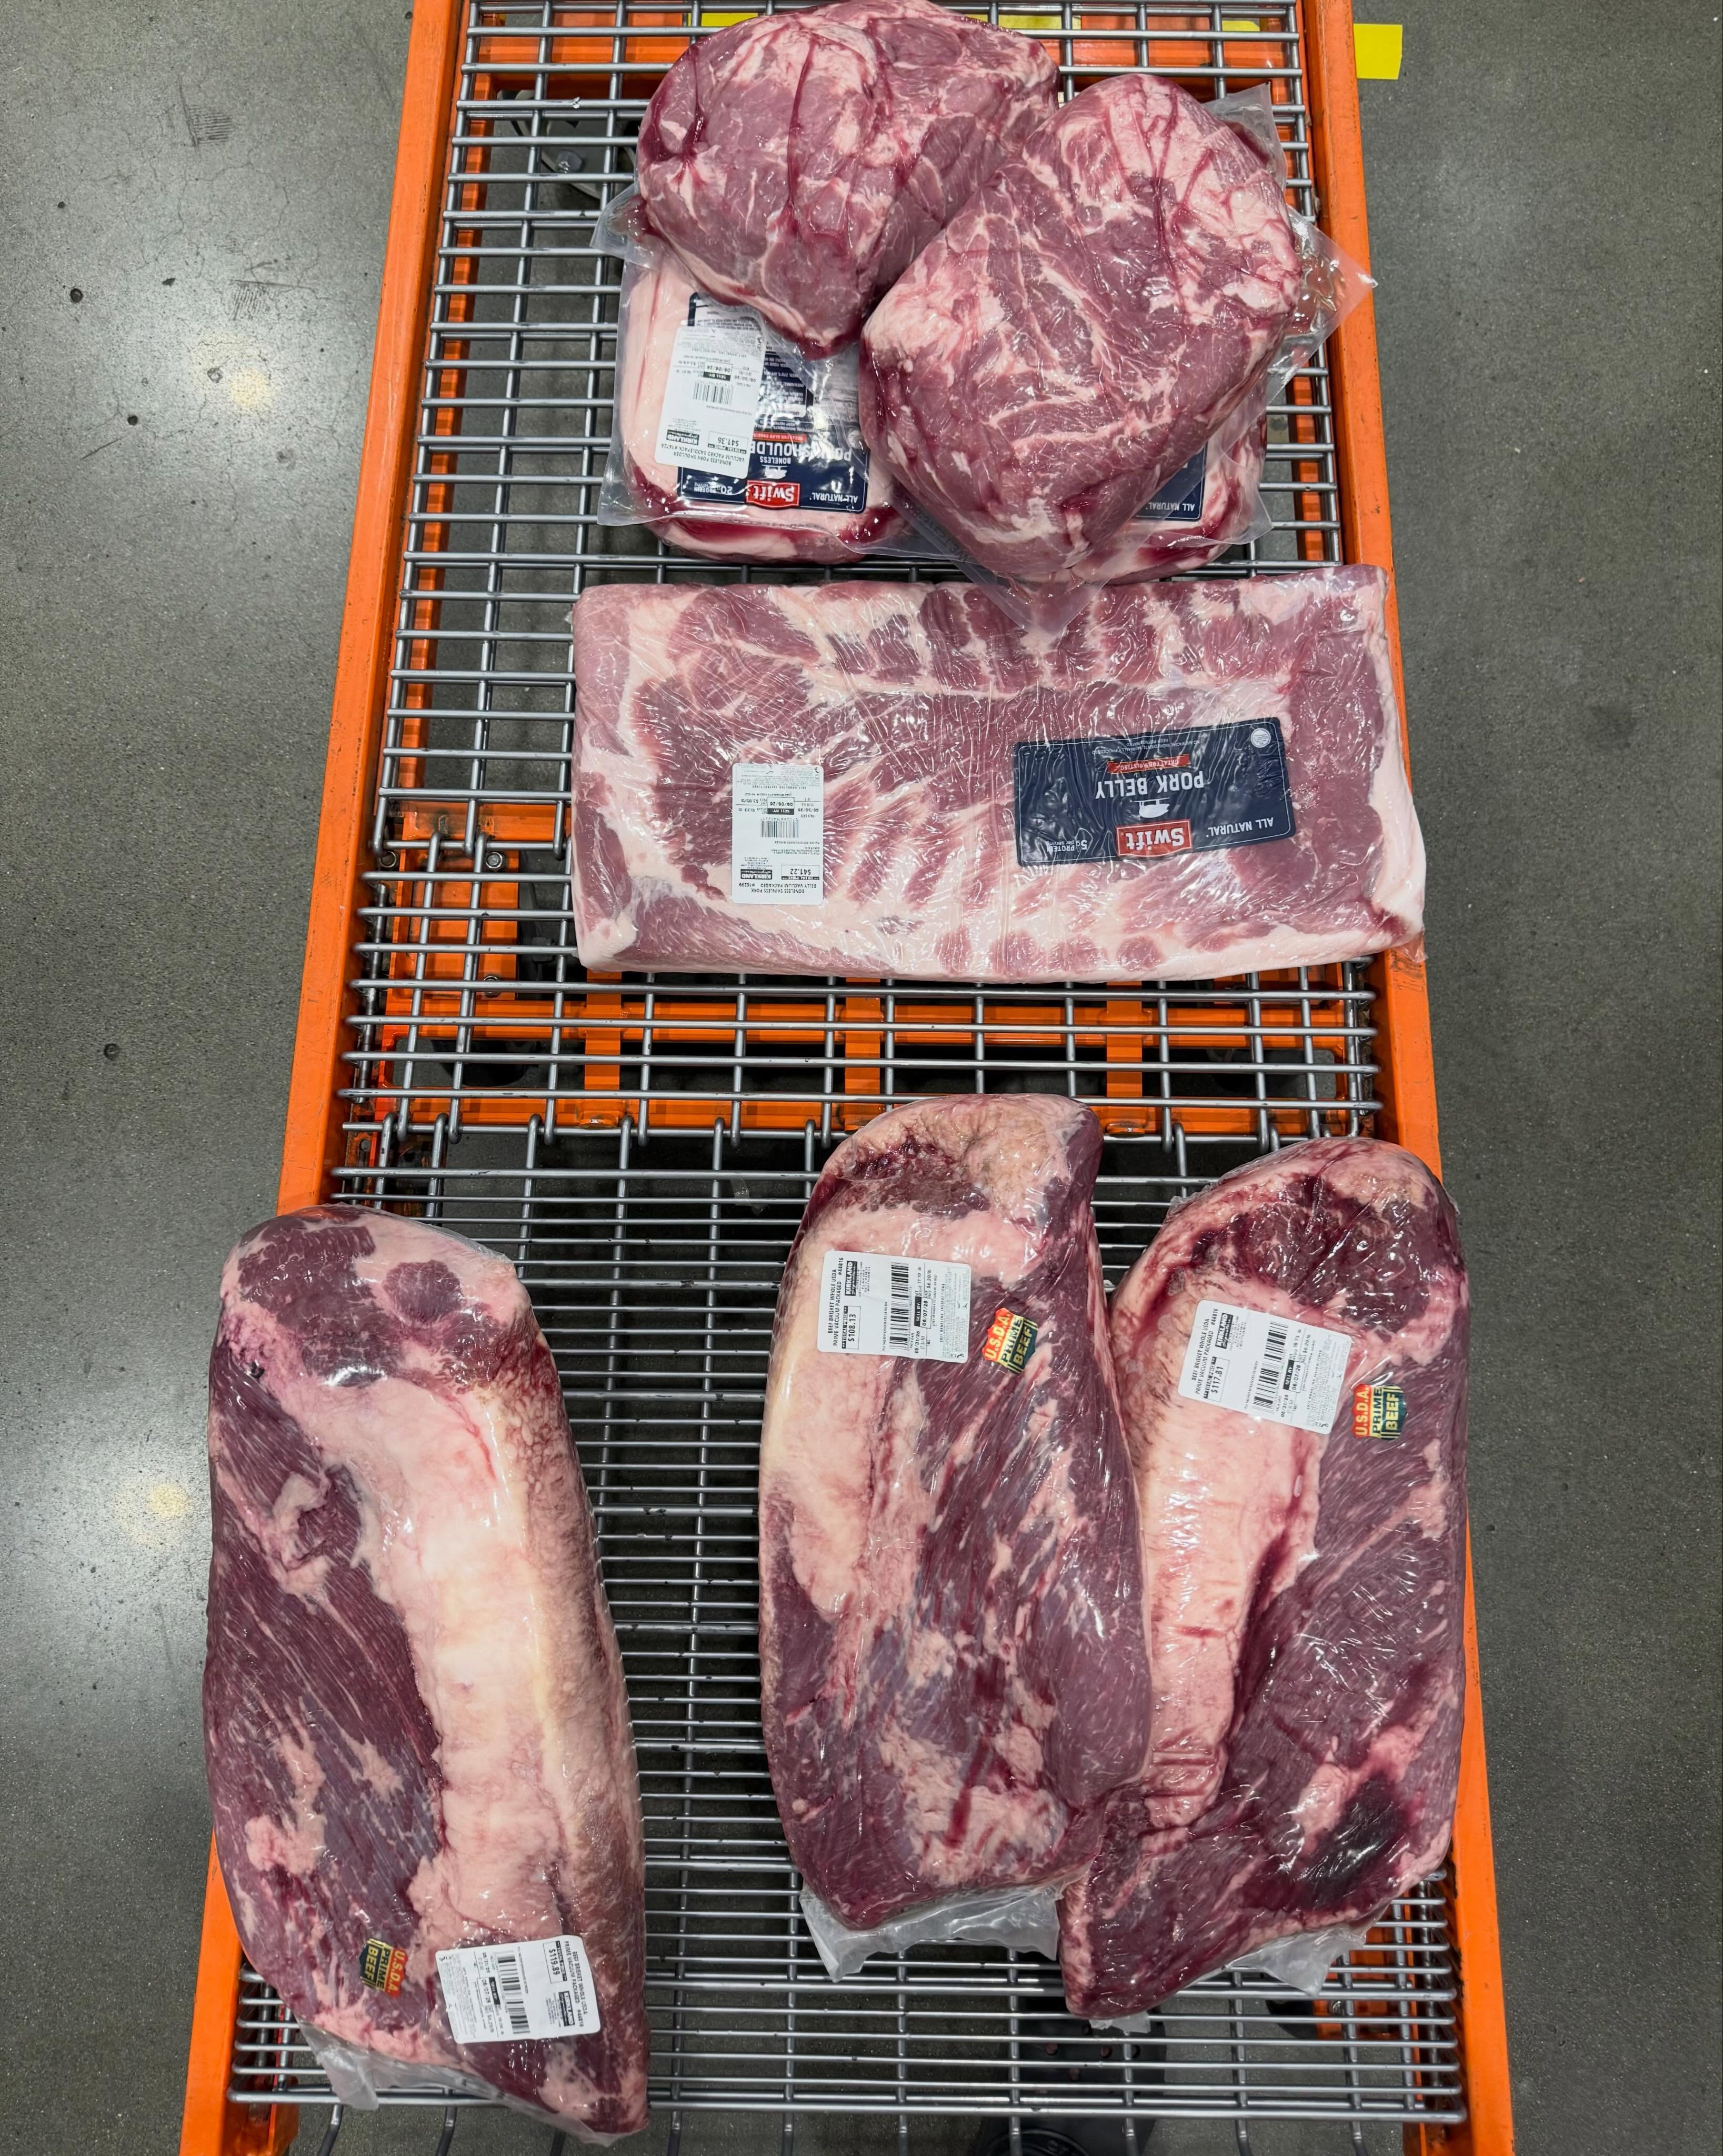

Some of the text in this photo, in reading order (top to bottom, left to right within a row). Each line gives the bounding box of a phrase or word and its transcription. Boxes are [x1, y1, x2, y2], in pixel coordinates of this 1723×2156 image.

[666, 434, 698, 444] KIRKLAND
[717, 436, 739, 447] $41.36
[673, 451, 696, 460] SHOULDER
[709, 457, 732, 465] BONELESS
[752, 484, 794, 504] Swift
[1147, 502, 1179, 510] NATURAL
[1093, 770, 1204, 799] PORK BELLY
[1124, 826, 1185, 852] Swift
[1207, 817, 1273, 836] ALL NATURAL
[1046, 838, 1087, 853] 5g PROTEIN
[845, 1261, 854, 1294] KIRKLAND
[847, 1313, 857, 1342] $108.13
[984, 1314, 1011, 1359] U.S.D.A.
[1001, 1318, 1022, 1362] PRIME
[1198, 1331, 1207, 1349] WHOLE
[1215, 1313, 1229, 1347] KIRKLAND
[1013, 1326, 1033, 1365] BEEF
[1203, 1330, 1214, 1355] PACKAGED
[1194, 1350, 1203, 1369] BRISKET
[1198, 1356, 1208, 1378] VACUUM
[1194, 1378, 1203, 1394] PRIME
[1210, 1365, 1224, 1393] $117.81
[1355, 1387, 1369, 1435] U.S.D.A.
[1372, 1388, 1382, 1433] PRIME
[1385, 1393, 1399, 1430] BEEF
[363, 1945, 378, 1980] BEEF
[377, 1948, 390, 1989] PRIME
[387, 1950, 405, 1992] U.S.D.A.
[548, 1948, 560, 1975] $119.89
[574, 1962, 583, 1982] BRISKET
[571, 1978, 579, 2003] PACKAGED
